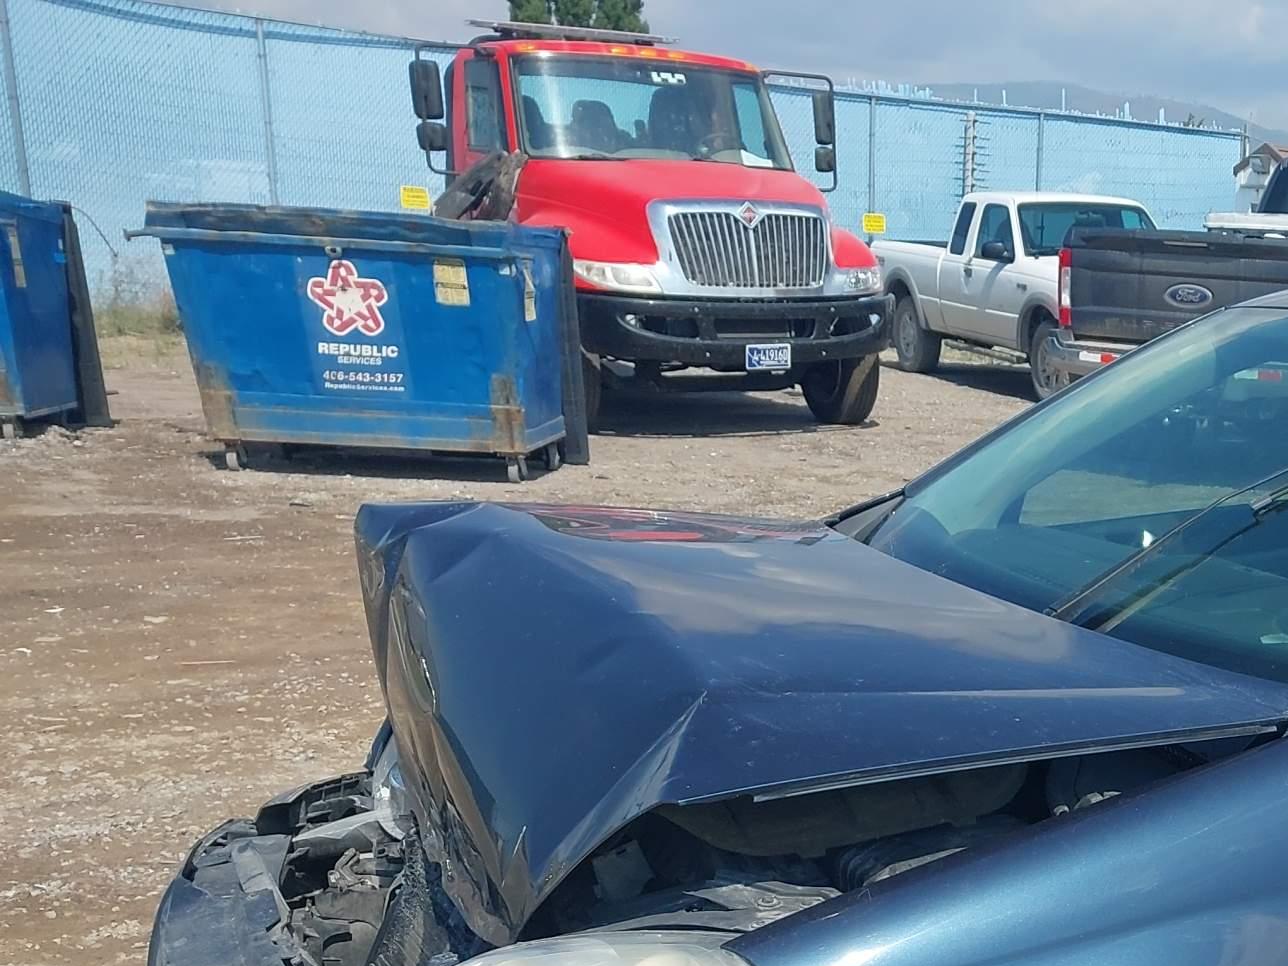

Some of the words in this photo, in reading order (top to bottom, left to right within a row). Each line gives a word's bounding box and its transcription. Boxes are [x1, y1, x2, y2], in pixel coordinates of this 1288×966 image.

[1175, 288, 1201, 302] Ford
[318, 342, 399, 358] REPUBLIC
[337, 356, 382, 365] SERVICES
[323, 370, 403, 383] 406-543-3157
